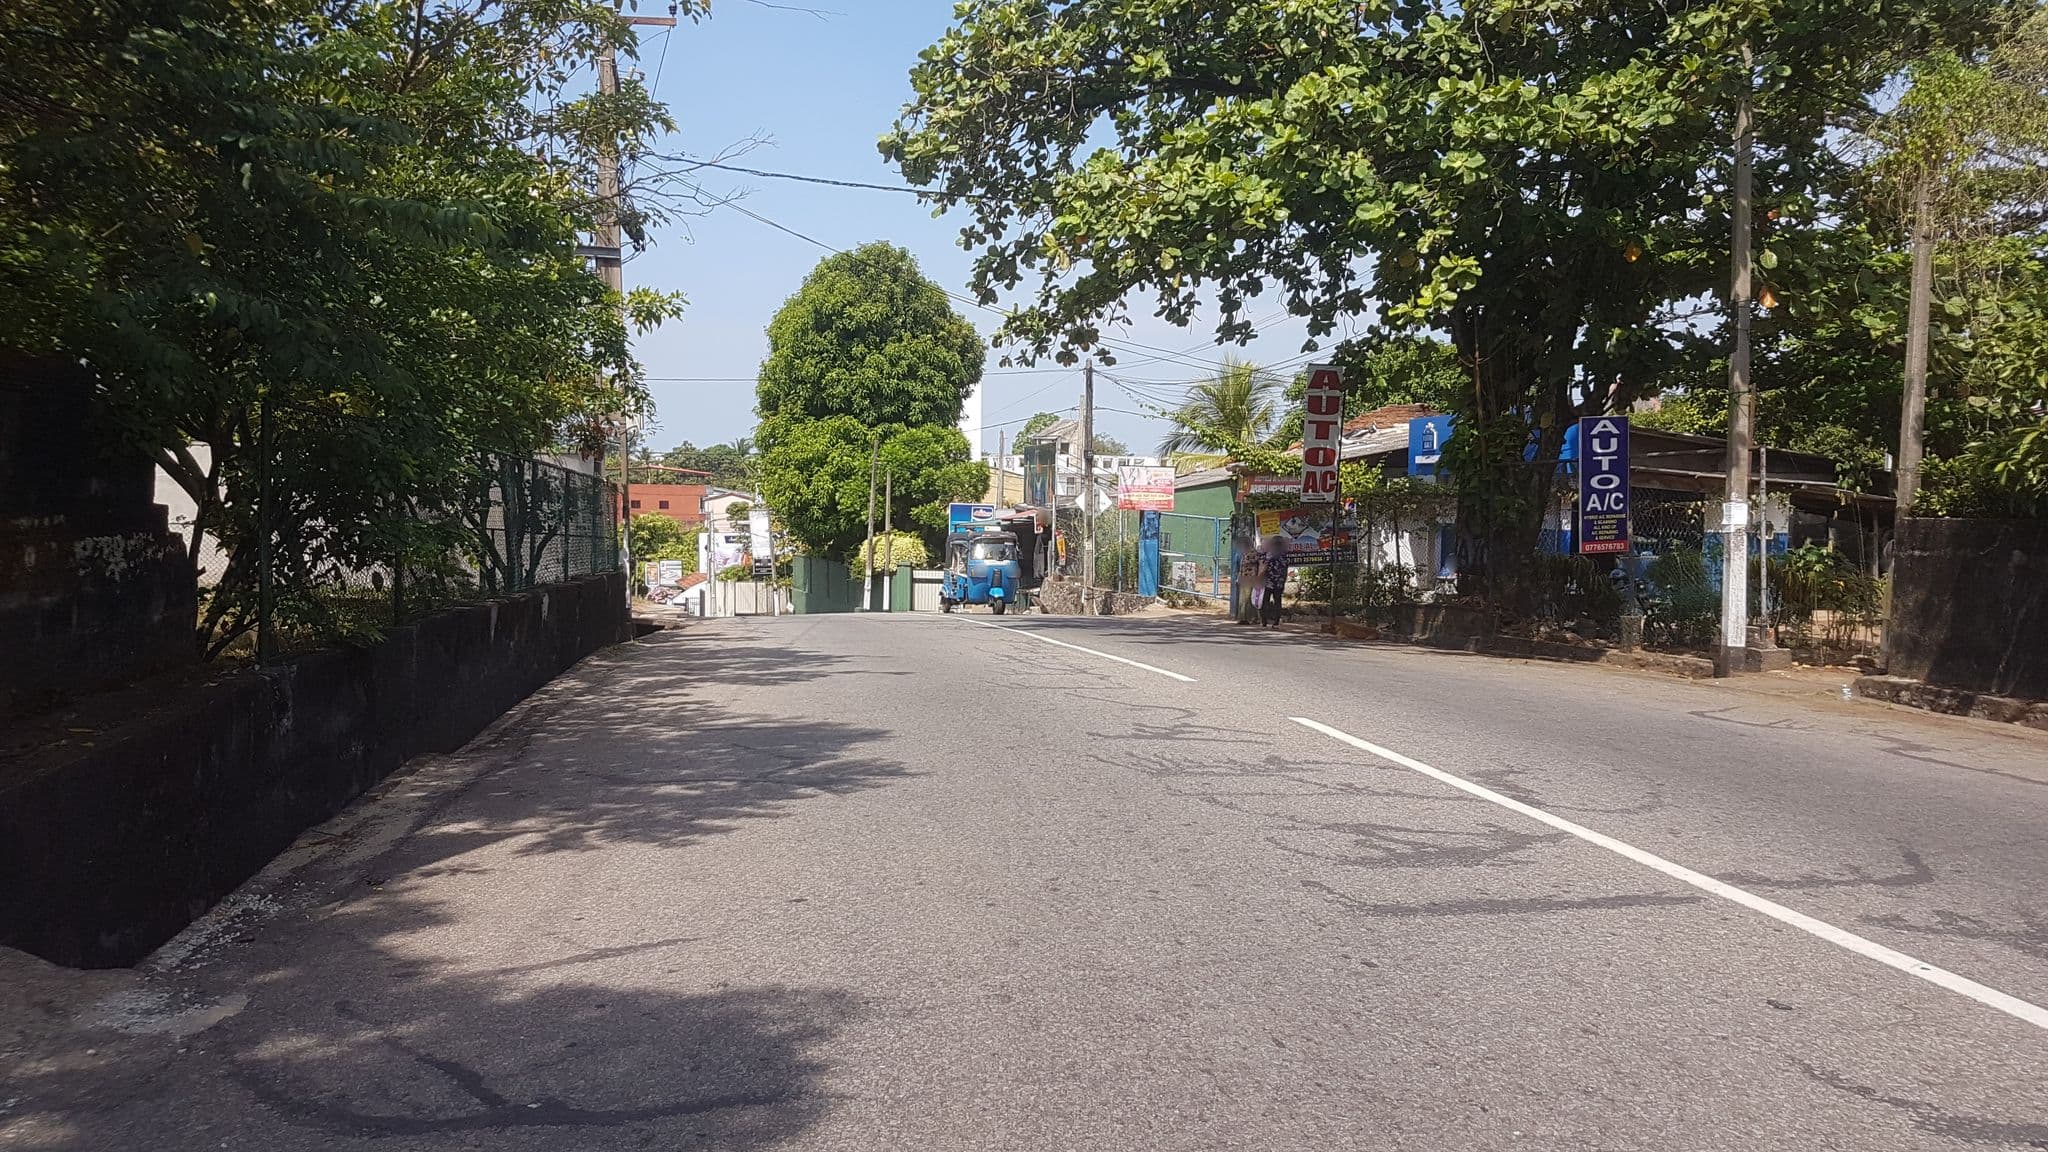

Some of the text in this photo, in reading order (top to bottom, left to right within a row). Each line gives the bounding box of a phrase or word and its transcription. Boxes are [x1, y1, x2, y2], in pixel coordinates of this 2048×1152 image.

[1305, 370, 1341, 467] AUTO
[1590, 419, 1621, 490] AUTO
[1586, 492, 1624, 511] A/C
